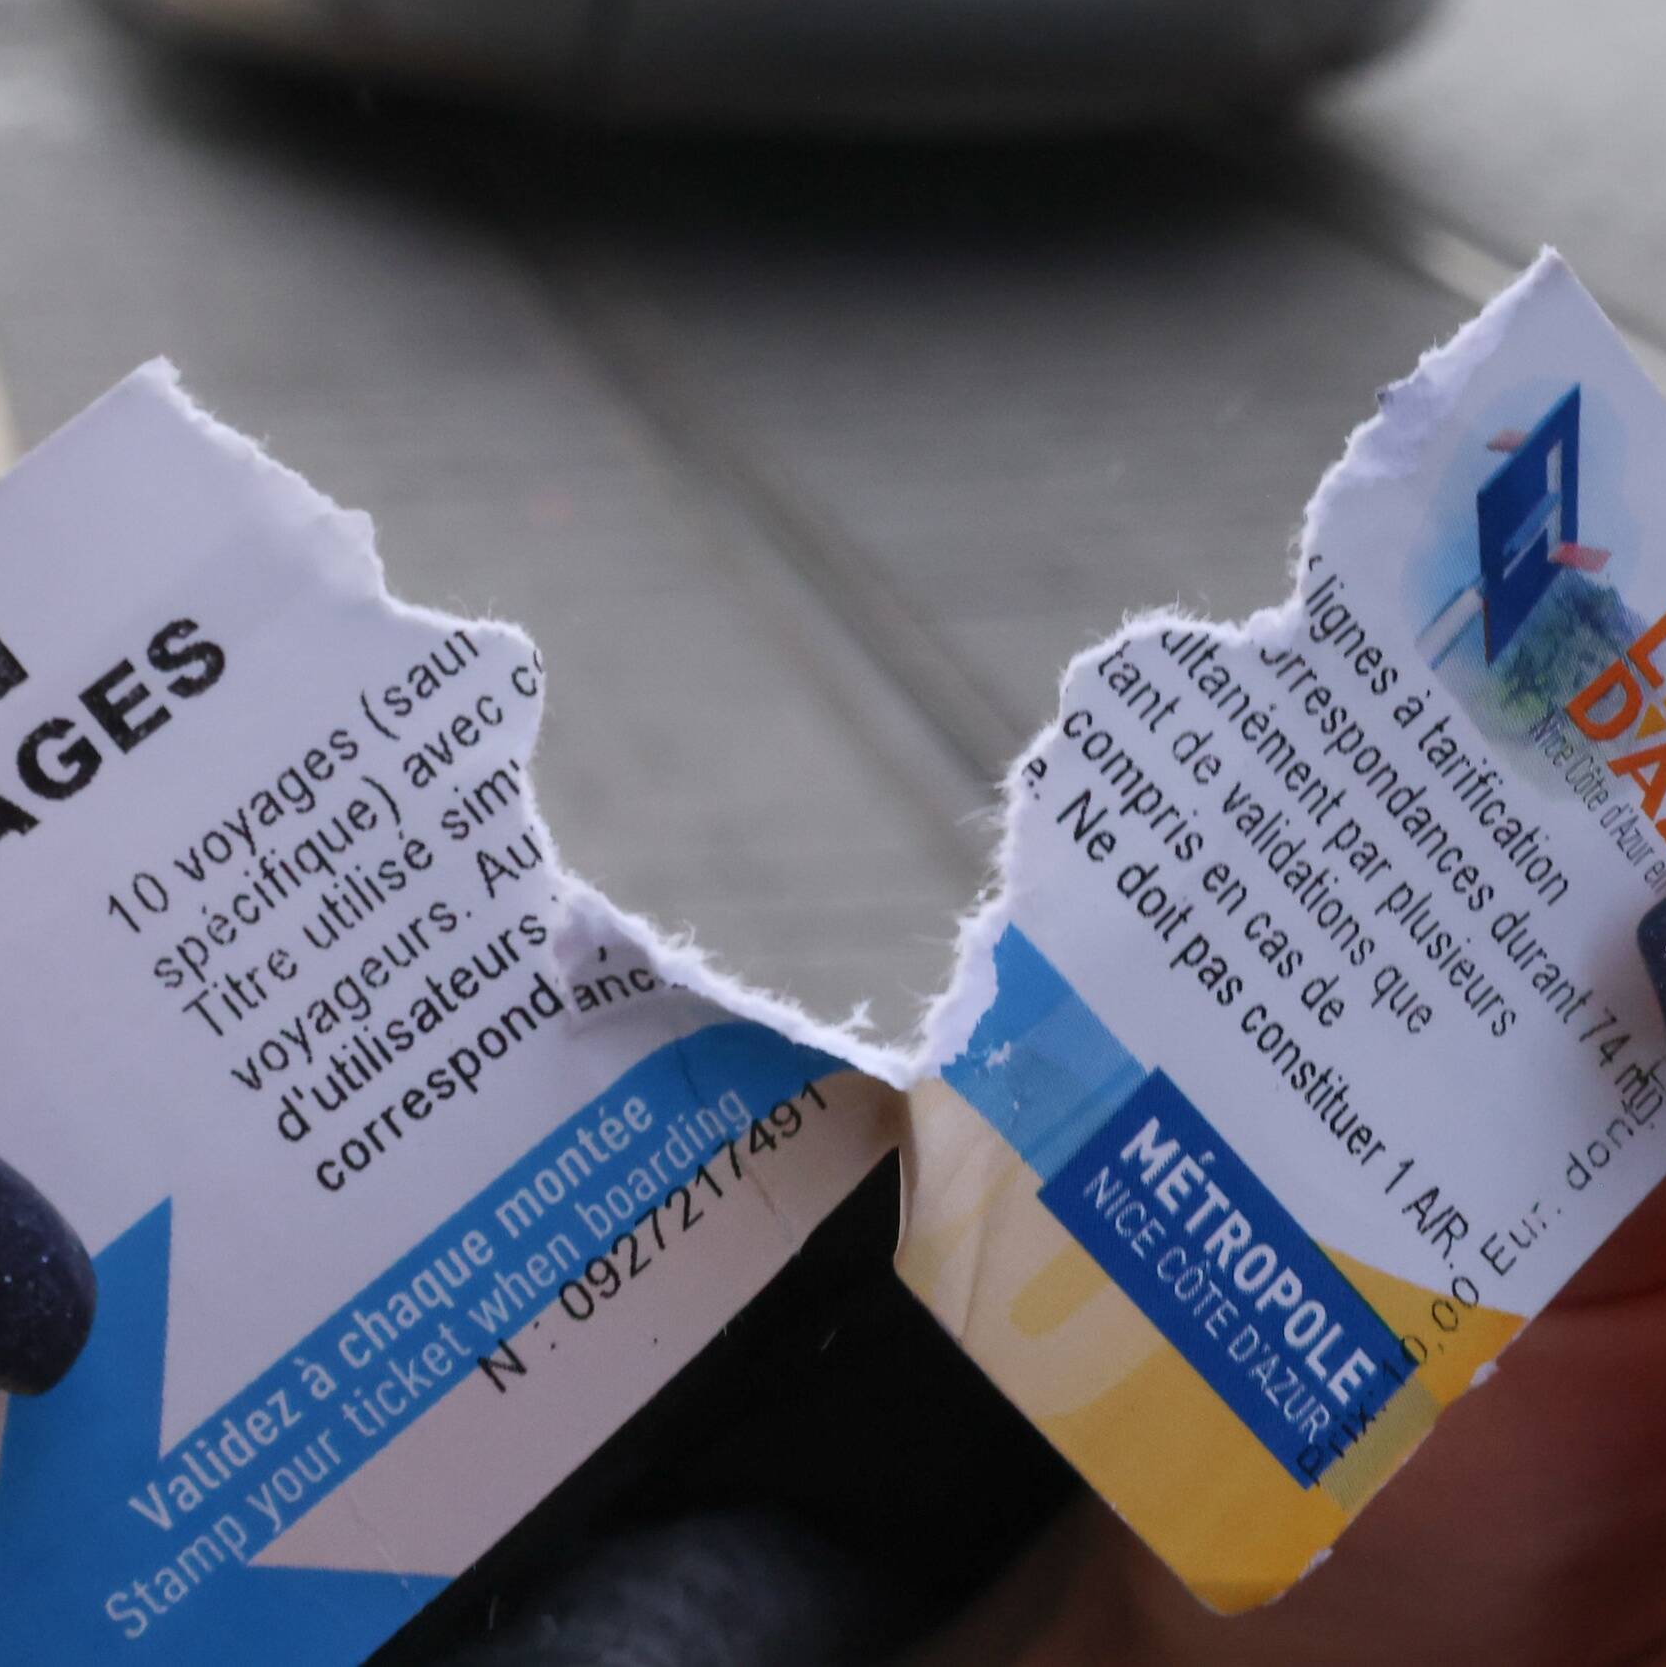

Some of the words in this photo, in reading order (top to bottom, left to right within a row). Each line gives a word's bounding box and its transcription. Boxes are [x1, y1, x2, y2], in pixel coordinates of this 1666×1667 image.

[107, 872, 170, 934] 10
[173, 730, 358, 882] voyages
[154, 776, 401, 988] spécifique)
[403, 696, 503, 788] avec
[511, 648, 543, 697] c
[1063, 710, 1203, 861] compris
[1203, 863, 1246, 916] en
[1246, 912, 1303, 978] cas
[1301, 978, 1344, 1027] de
[1306, 574, 1398, 695] lignes
[1393, 691, 1430, 730] à
[1418, 716, 1568, 906] tarification
[1570, 756, 1608, 811] Côte
[1601, 804, 1656, 869] d'Azur
[182, 949, 297, 1036] Titre
[303, 831, 433, 949] utilisé
[441, 759, 520, 840] sim
[231, 902, 471, 1091] voyageurs.
[477, 833, 542, 899] Au
[1173, 731, 1221, 784] de
[1222, 782, 1375, 966] validations
[1375, 967, 1432, 1034] que
[1328, 818, 1393, 883] par
[1380, 881, 1517, 1037] plusieurs
[1491, 912, 1591, 1024] durant
[278, 915, 547, 1142] d'utilisateurs
[1056, 791, 1116, 862] Ne
[1117, 864, 1191, 943] doit
[1173, 933, 1243, 1006] pas
[1241, 1004, 1386, 1166] constituer
[1385, 1157, 1412, 1195] 1
[1403, 1187, 1470, 1269] A/R.
[128, 1390, 302, 1530] Validez
[303, 1360, 337, 1400] à
[341, 1233, 496, 1368] chaque
[497, 1096, 657, 1232] montée
[558, 1082, 827, 1321] 0927217491
[1084, 1166, 1165, 1258] NICE
[1157, 1247, 1238, 1339] CÔTE
[1228, 1324, 1330, 1443] D'AZUR
[1120, 1117, 1376, 1406] MÉTROPOLE
[1482, 1202, 1561, 1276] Eur.
[105, 1515, 246, 1638] Stamp
[248, 1431, 344, 1531] your
[343, 1327, 474, 1436] ticket
[470, 1234, 580, 1334] when
[575, 1089, 753, 1240] boarding
